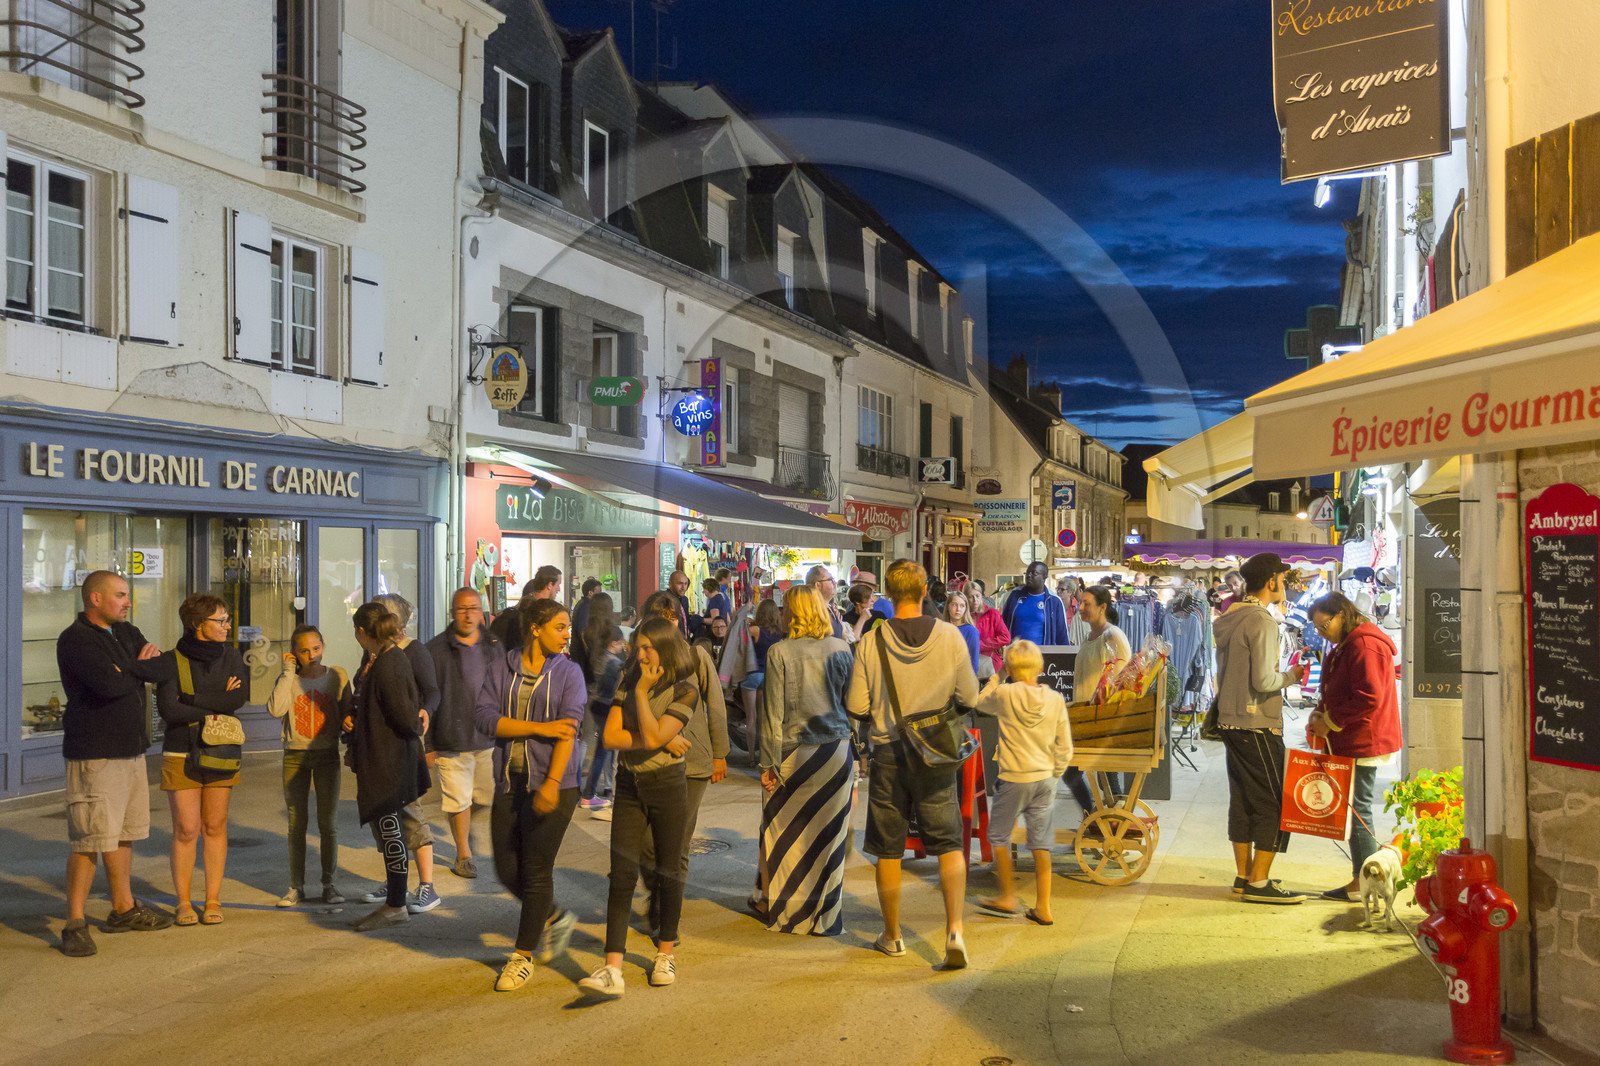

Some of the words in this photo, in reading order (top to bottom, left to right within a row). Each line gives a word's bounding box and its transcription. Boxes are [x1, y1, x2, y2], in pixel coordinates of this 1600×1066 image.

[1285, 72, 1333, 104] Les
[1340, 59, 1438, 99] caprices
[1311, 105, 1412, 141] d'Anaïs
[492, 387, 518, 402] Leffe
[594, 386, 620, 397] PMU
[679, 400, 700, 414] Bar
[674, 415, 682, 427] à
[687, 409, 713, 424] vins
[1330, 407, 1453, 463] Épicerie
[30, 441, 65, 478] LE
[84, 447, 211, 488] FOURNIL
[226, 460, 257, 491] DE
[272, 465, 360, 498] CARNAC
[522, 493, 544, 521] La
[552, 495, 585, 524] Bise
[973, 502, 1026, 510] POISSONNERIE
[1419, 522, 1449, 538] Les
[1529, 509, 1598, 531] Ambryzel
[1418, 683, 1432, 693] 02
[1437, 683, 1451, 693] 97
[1535, 716, 1584, 742] Chocolats
[1292, 756, 1309, 765] Aux
[379, 811, 407, 874] ADID
